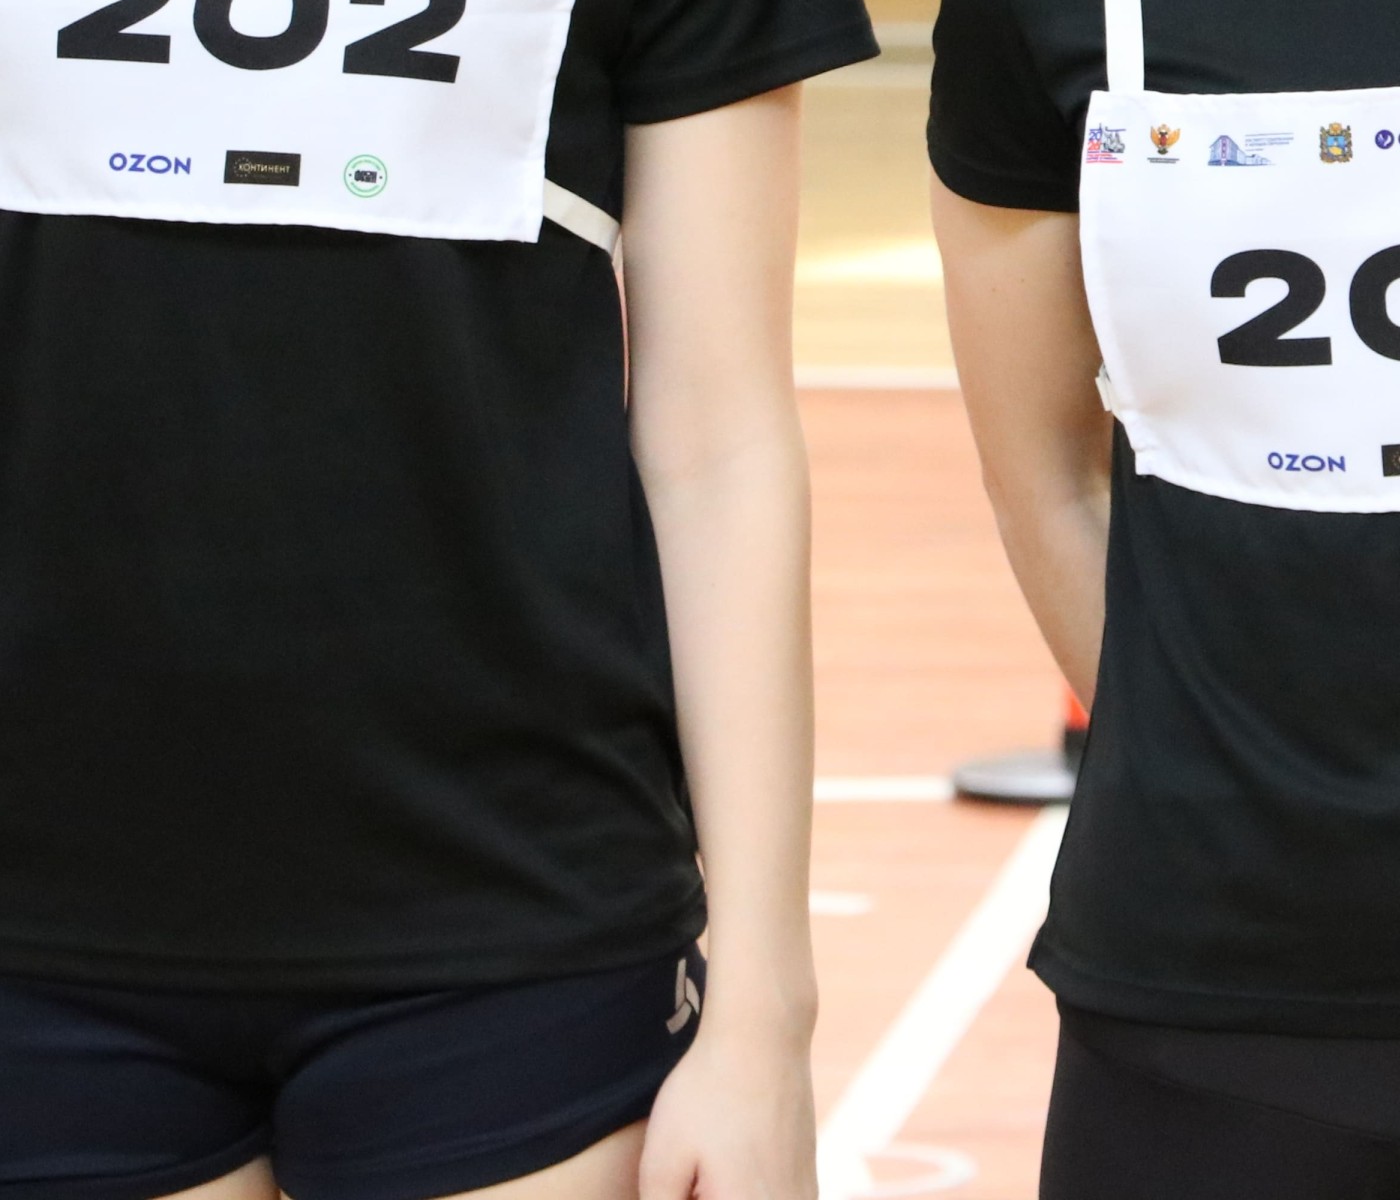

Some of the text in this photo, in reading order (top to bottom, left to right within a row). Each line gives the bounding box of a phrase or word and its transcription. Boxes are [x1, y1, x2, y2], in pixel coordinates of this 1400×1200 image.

[109, 152, 191, 175] OZON
[238, 163, 291, 174] КОНТИНЕНТ
[1267, 452, 1346, 472] OZON
